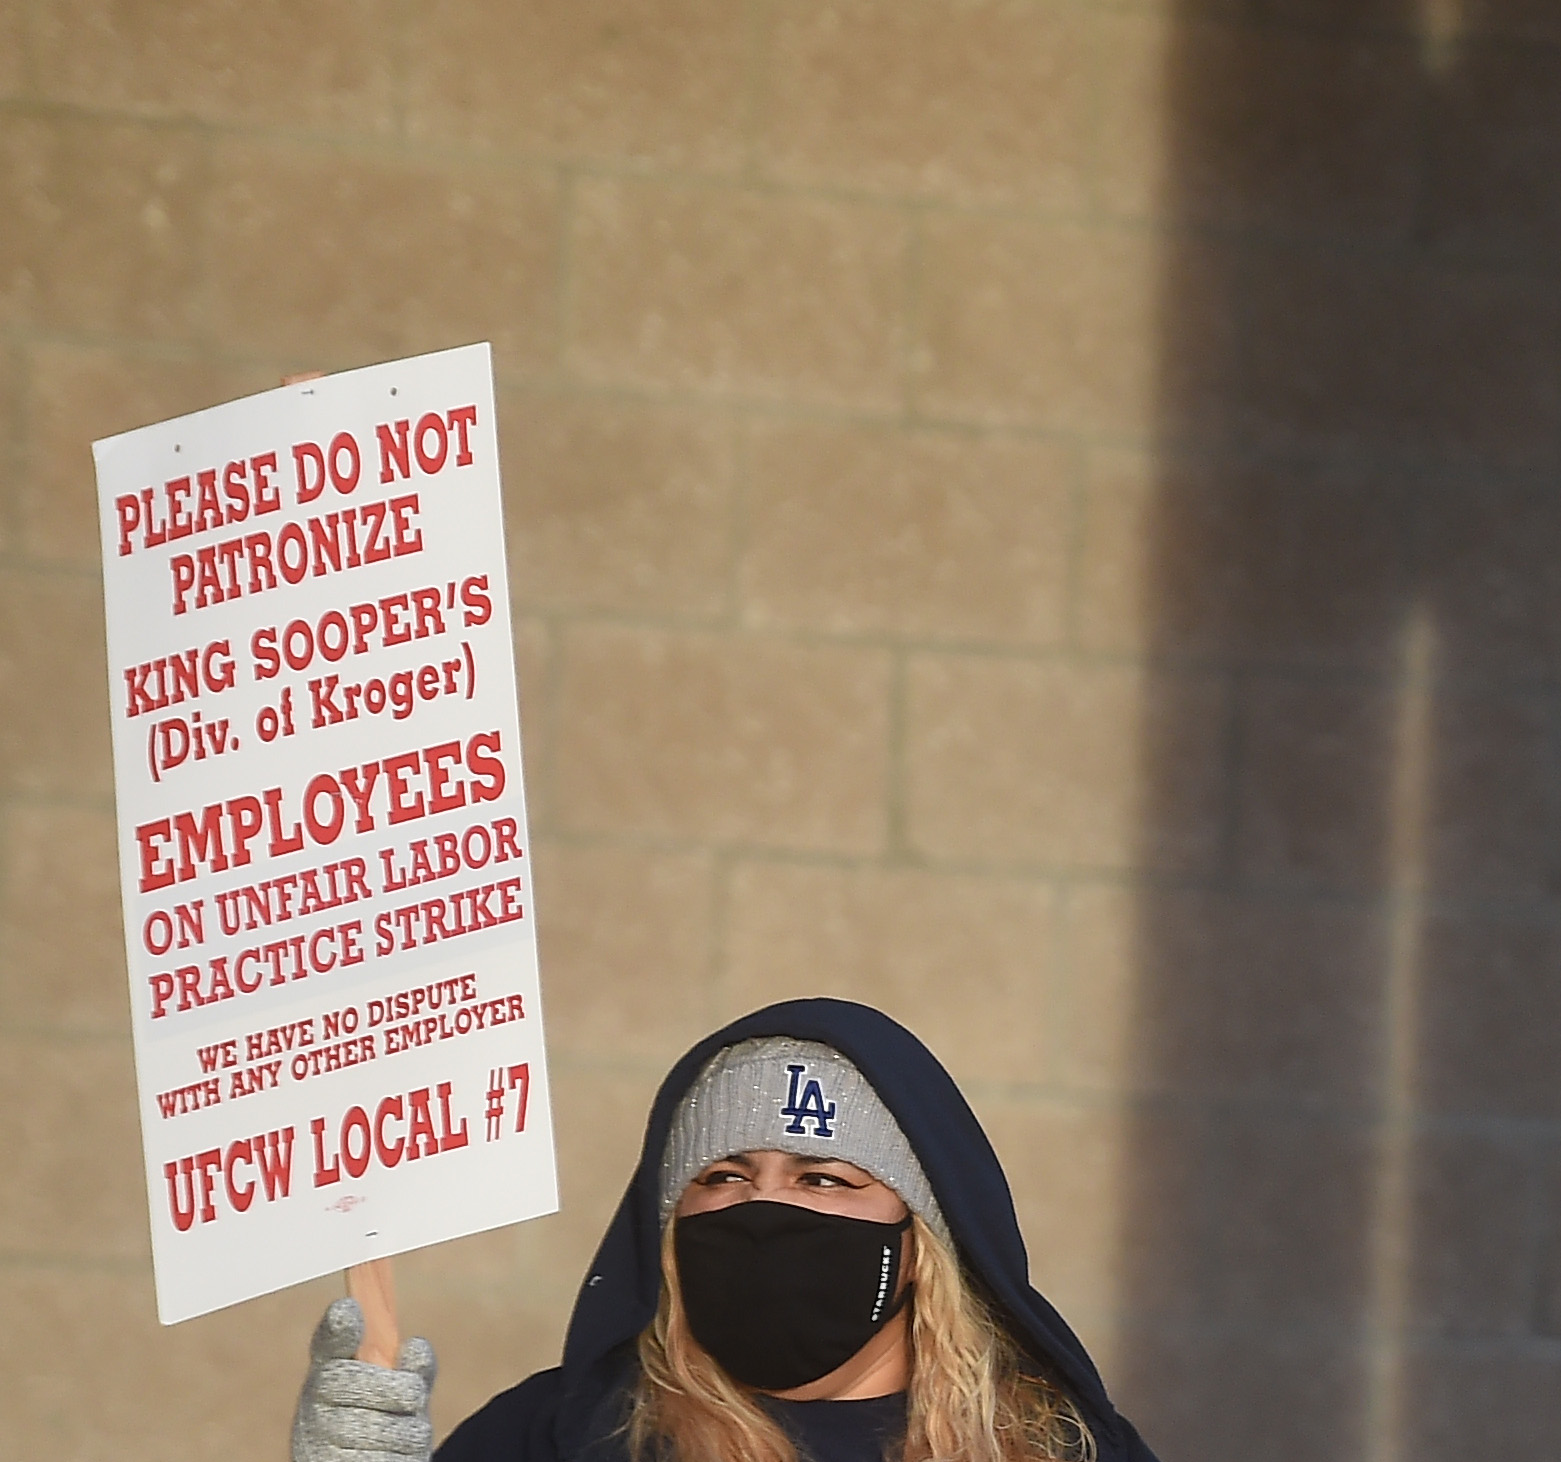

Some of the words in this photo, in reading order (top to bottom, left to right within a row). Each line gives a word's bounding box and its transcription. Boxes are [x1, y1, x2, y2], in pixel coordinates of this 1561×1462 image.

[117, 452, 281, 556] PLEASE
[293, 432, 361, 503] DO
[377, 406, 476, 483] NOT
[172, 494, 423, 614] PATRONIZE
[126, 641, 236, 717] KING
[252, 576, 492, 680] SOOPER'S
[149, 712, 240, 781] (Div.
[257, 688, 294, 742] of
[309, 643, 475, 728] Kroger)
[137, 731, 505, 893] EMPLOYEES
[145, 900, 204, 955] ON
[216, 858, 373, 935] UNFAIR
[381, 818, 522, 892] LABOR
[150, 921, 364, 1018] PRACTICE
[376, 878, 523, 956] STRIKE
[158, 1078, 222, 1117] WITH
[231, 1061, 283, 1098] ANY
[292, 1035, 376, 1080] OTHER
[385, 995, 525, 1054] EMPLOYER
[198, 1040, 238, 1072] WE
[247, 1019, 315, 1061] HAVE
[324, 1008, 359, 1040] NO
[368, 974, 477, 1027] DISPUTE
[165, 1127, 295, 1231] UFCW
[312, 1082, 468, 1187] LOCAL
[486, 1064, 529, 1142] #7
[780, 1065, 836, 1137] LA
